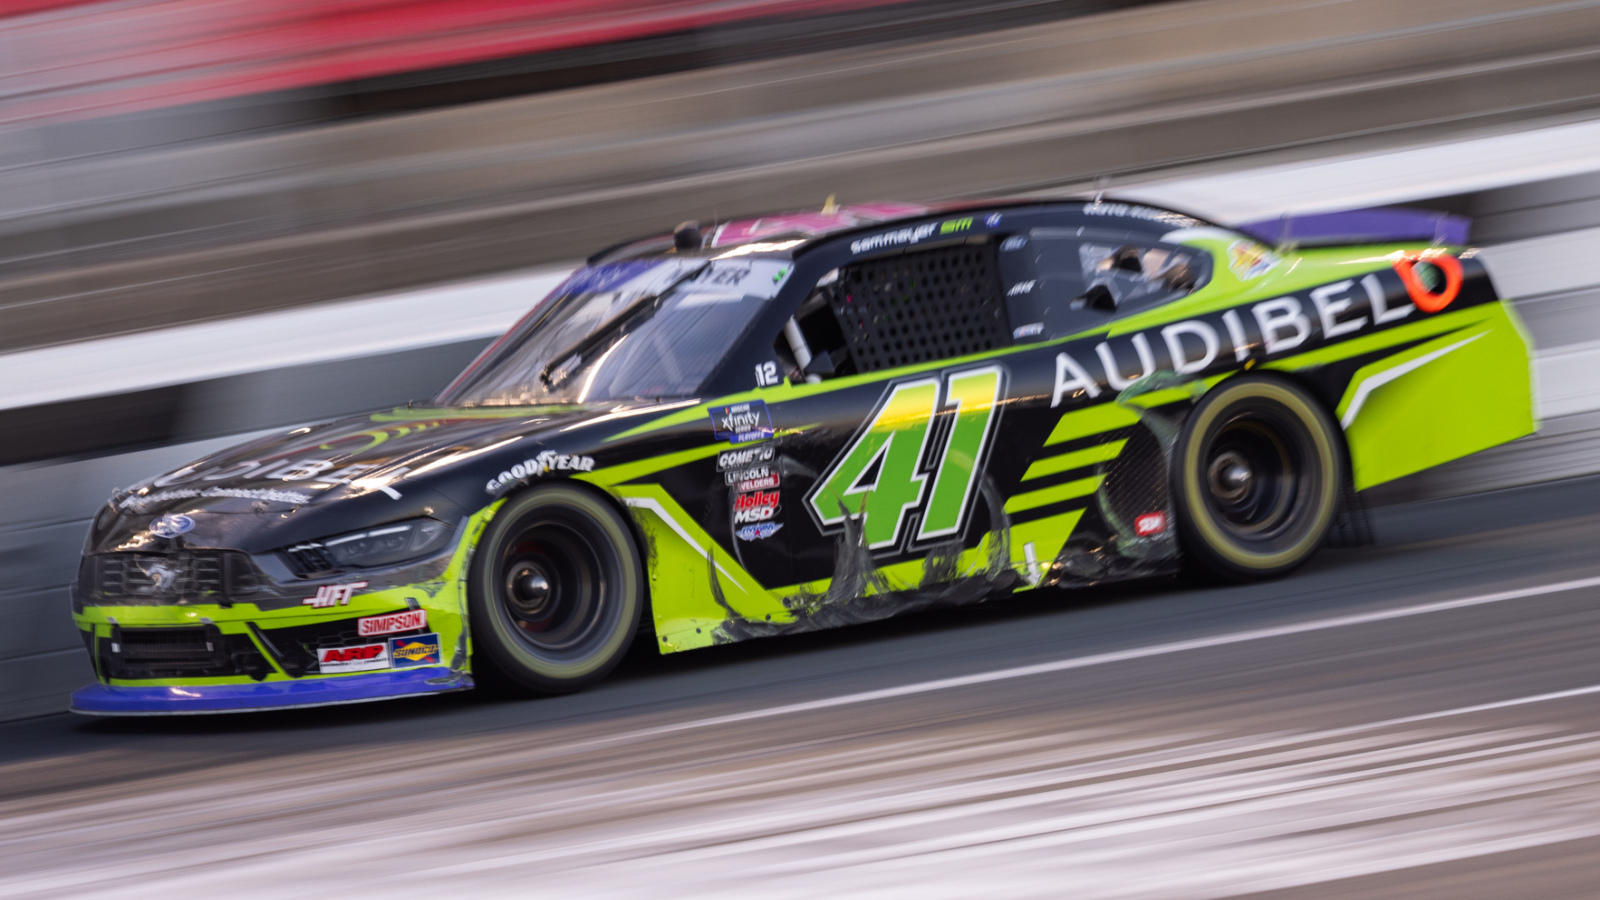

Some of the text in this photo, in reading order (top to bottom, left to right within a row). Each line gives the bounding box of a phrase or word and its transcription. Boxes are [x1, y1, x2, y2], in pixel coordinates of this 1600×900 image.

[1051, 273, 1418, 409] AUDIBEL
[755, 360, 779, 387] 12
[721, 411, 760, 432] xfinity
[807, 364, 1006, 551] 41
[485, 450, 595, 495] GOODYEAR
[727, 466, 769, 483] LINCOLN
[738, 477, 774, 491] WELDERS
[734, 491, 780, 511] Holley
[735, 505, 774, 525] MSD
[361, 612, 422, 634] SIMPSON
[320, 644, 384, 663] ARP
[392, 643, 440, 659] SUNOCO
